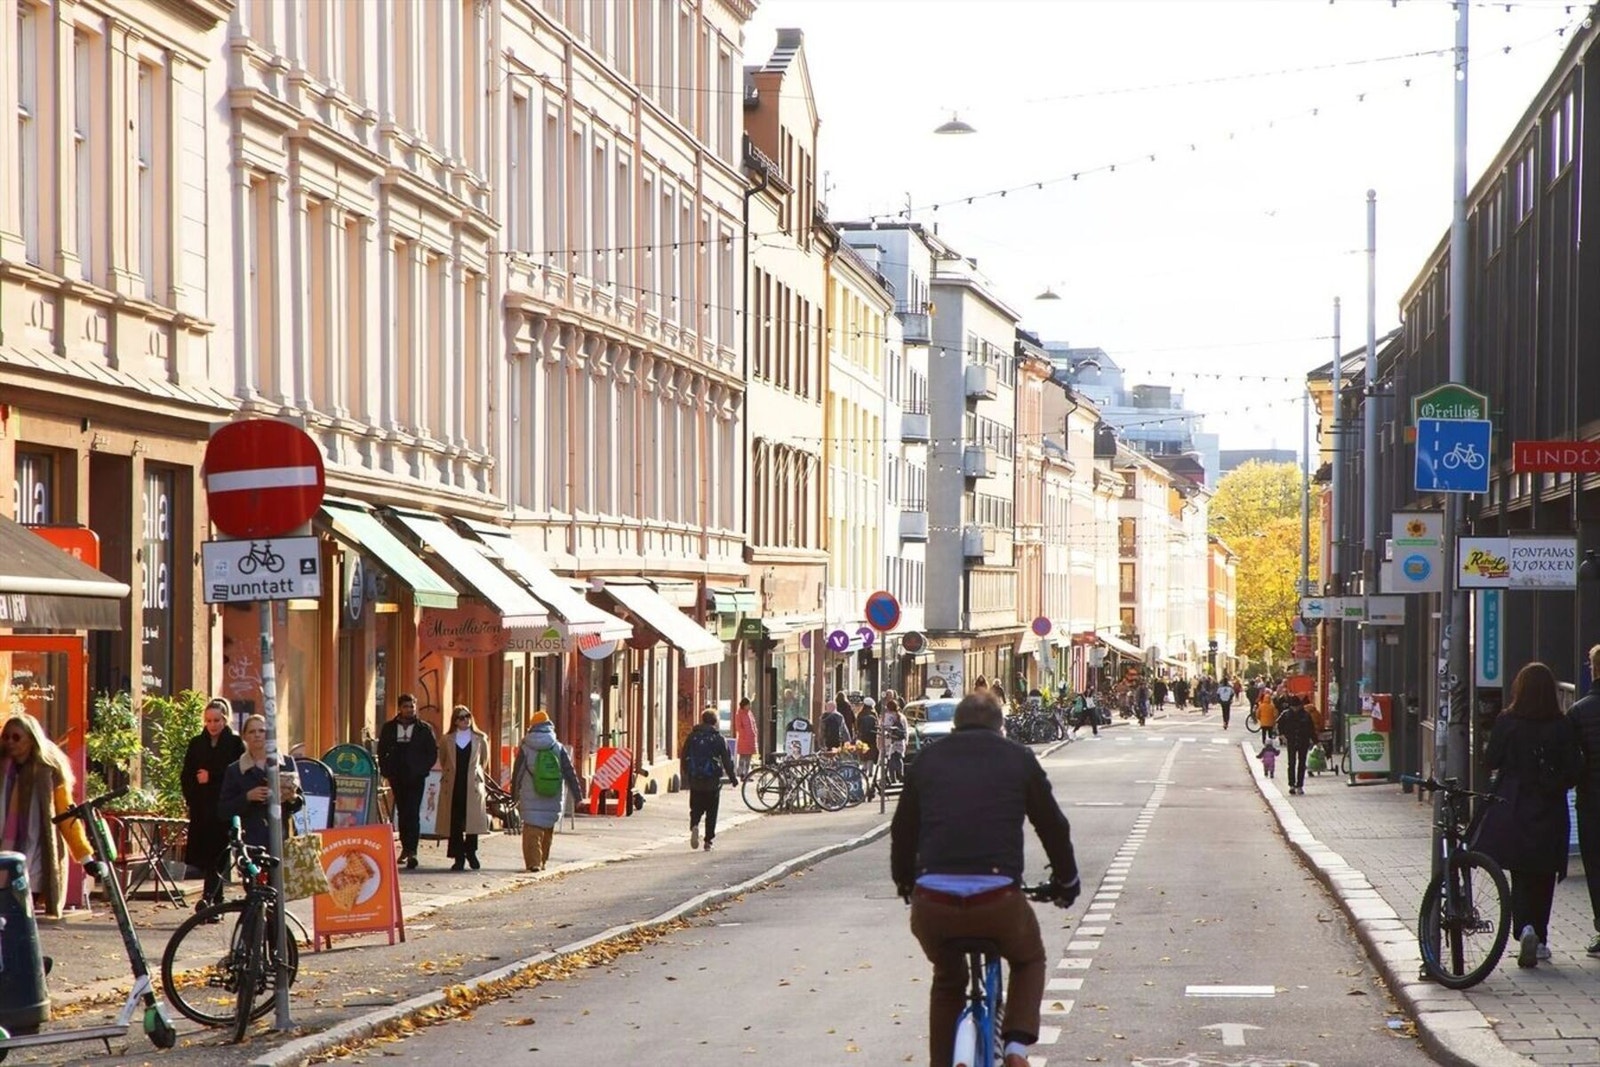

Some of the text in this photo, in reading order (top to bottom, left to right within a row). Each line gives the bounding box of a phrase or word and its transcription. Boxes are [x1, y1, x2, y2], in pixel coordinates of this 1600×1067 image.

[1512, 547, 1575, 558] FONTANAS
[1512, 560, 1575, 572] KJØKKEN
[230, 579, 294, 596] unntatt
[508, 636, 566, 650] sunkost
